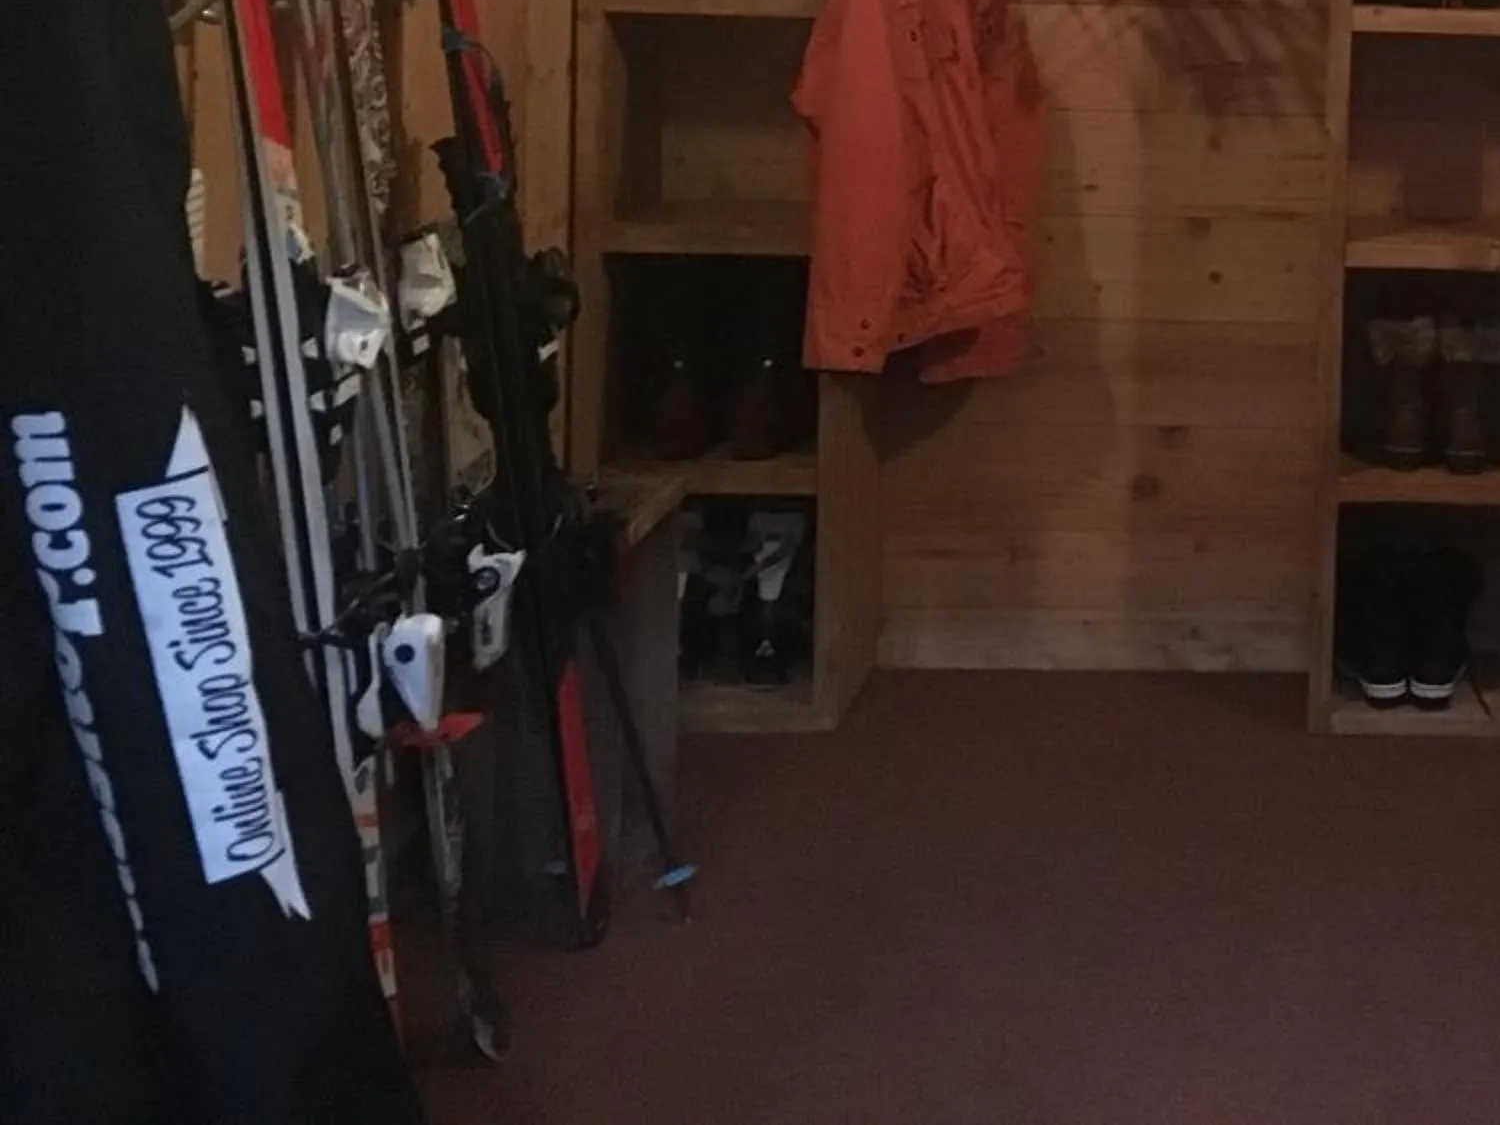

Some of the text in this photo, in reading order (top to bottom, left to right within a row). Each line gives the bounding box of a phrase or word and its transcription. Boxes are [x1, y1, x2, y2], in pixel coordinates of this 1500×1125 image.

[135, 495, 275, 862] Online Shop Since 1999
